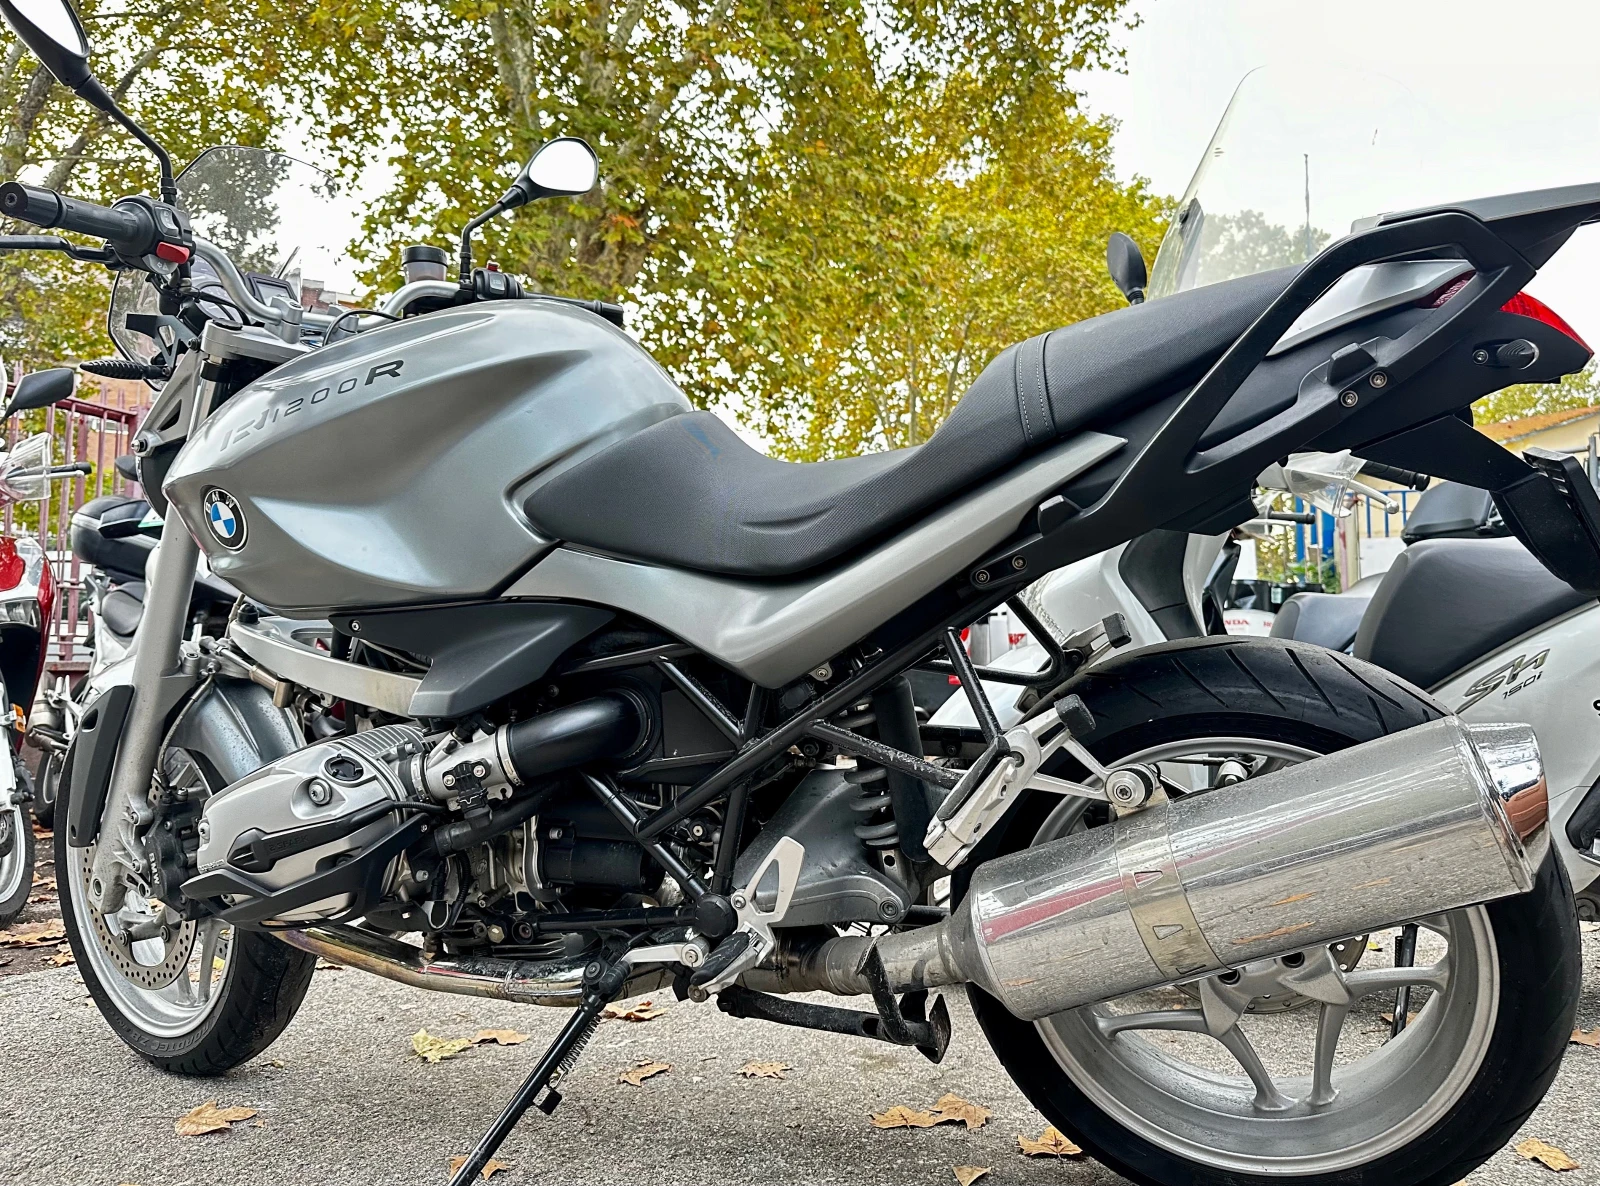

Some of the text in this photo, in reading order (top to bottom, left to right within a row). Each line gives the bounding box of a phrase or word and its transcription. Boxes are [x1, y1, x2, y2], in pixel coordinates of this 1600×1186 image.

[1454, 648, 1551, 716] SH
[1502, 670, 1544, 700] 150i
[149, 852, 160, 885] BMW
